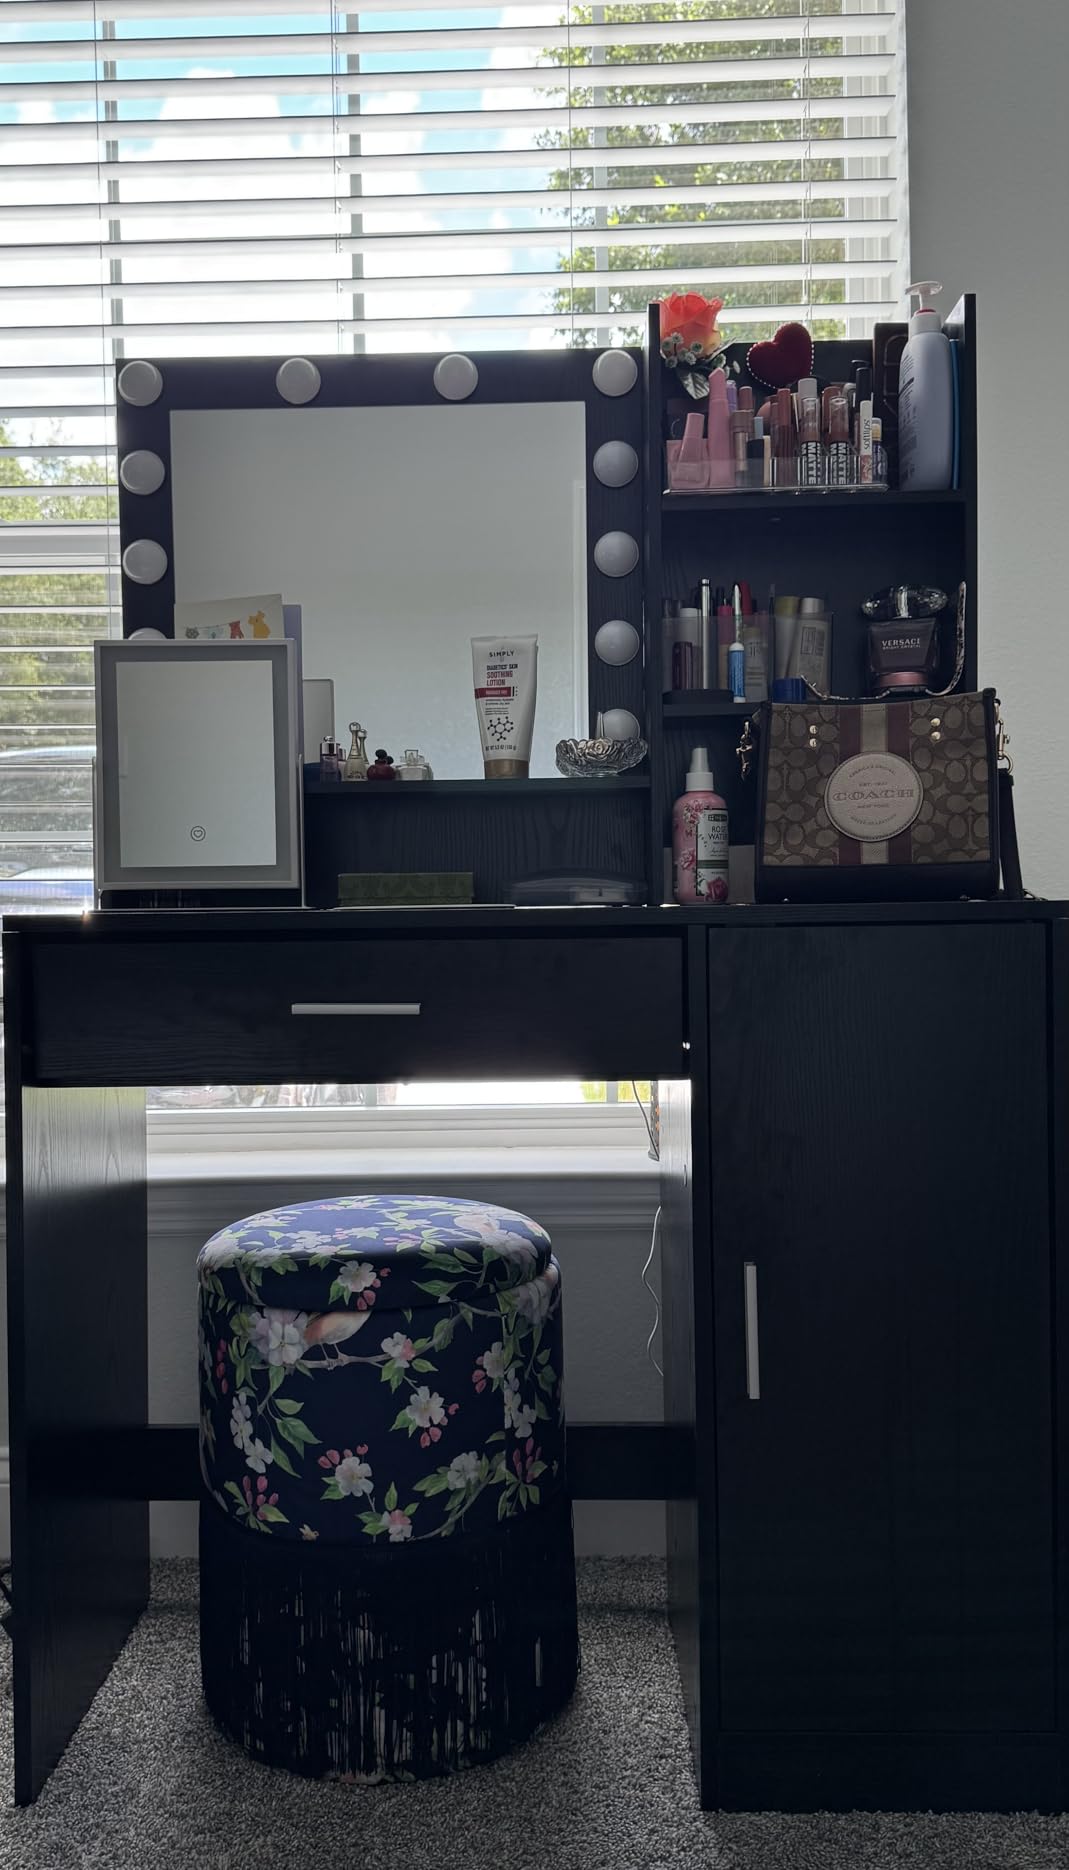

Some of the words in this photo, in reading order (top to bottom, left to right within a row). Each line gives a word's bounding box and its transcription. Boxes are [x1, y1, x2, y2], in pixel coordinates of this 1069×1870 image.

[807, 442, 817, 485] MATTE
[838, 442, 847, 485] MATTE
[486, 671, 513, 679] SOOTHING
[832, 789, 914, 800] COACH
